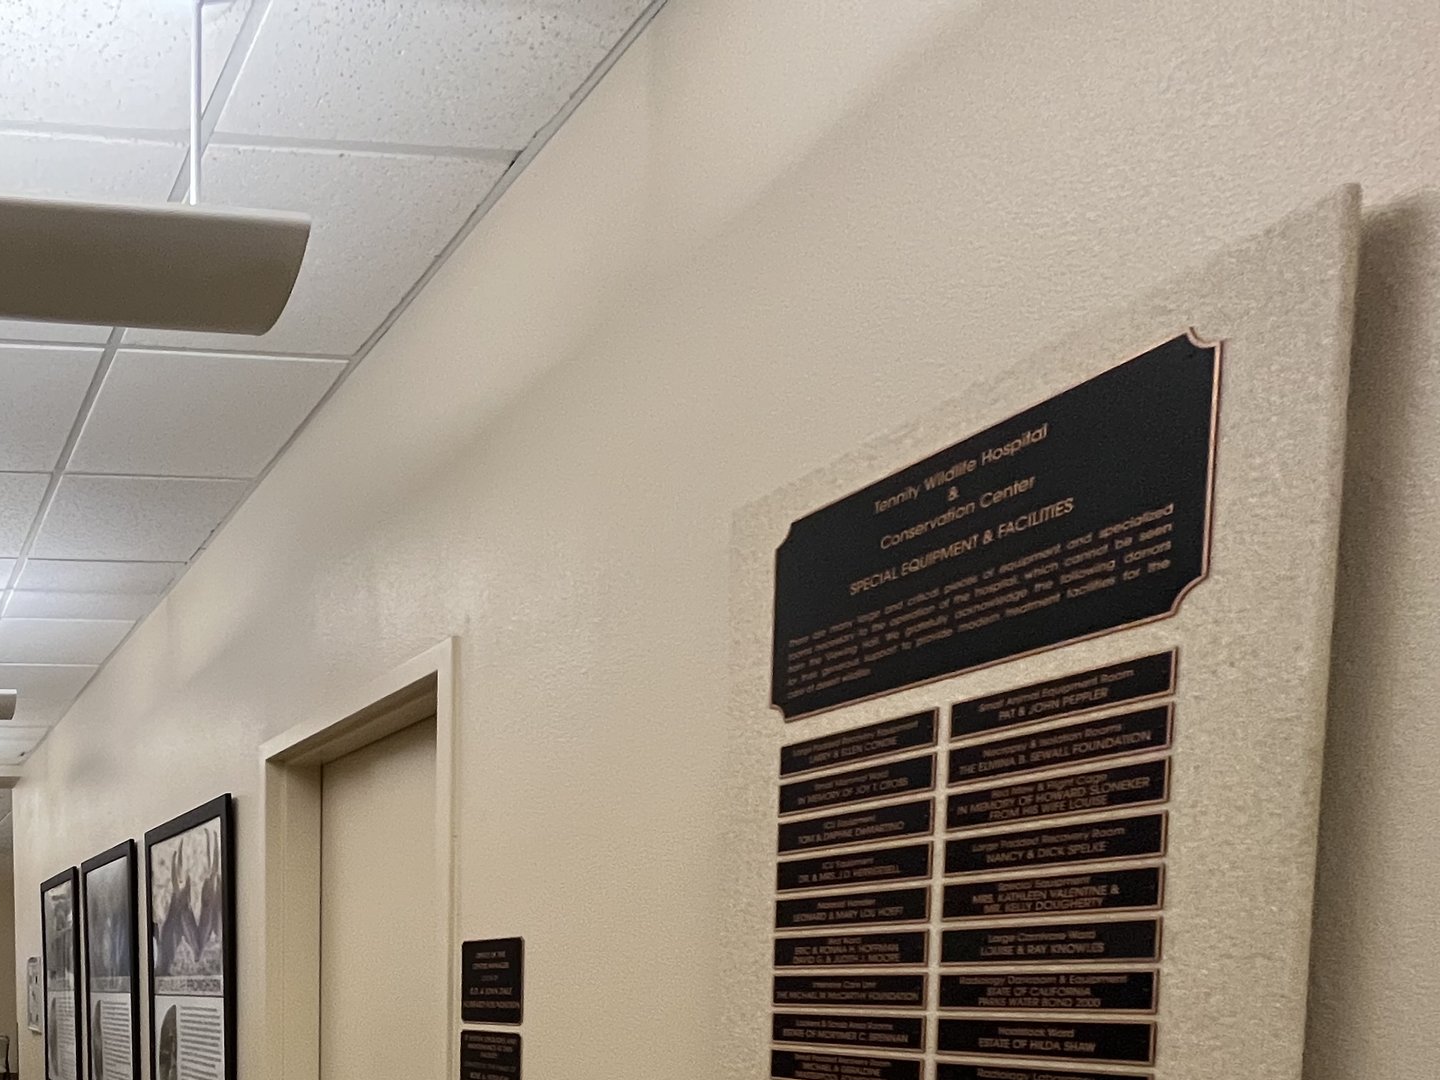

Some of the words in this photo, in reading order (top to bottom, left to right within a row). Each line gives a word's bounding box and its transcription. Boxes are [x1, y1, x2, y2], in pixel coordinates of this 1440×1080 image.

[875, 486, 919, 513] Tennity
[924, 460, 976, 490] Wildlife
[982, 423, 1047, 465] Hospital
[948, 486, 958, 500] &
[850, 568, 898, 595] SPECIAL
[901, 534, 978, 576] EQUIPMENT
[983, 530, 994, 544] &
[998, 498, 1073, 538] FACILITIES
[880, 502, 975, 549] Conservation
[980, 476, 1034, 508] Center
[1072, 730, 1150, 753] FOUNDATION
